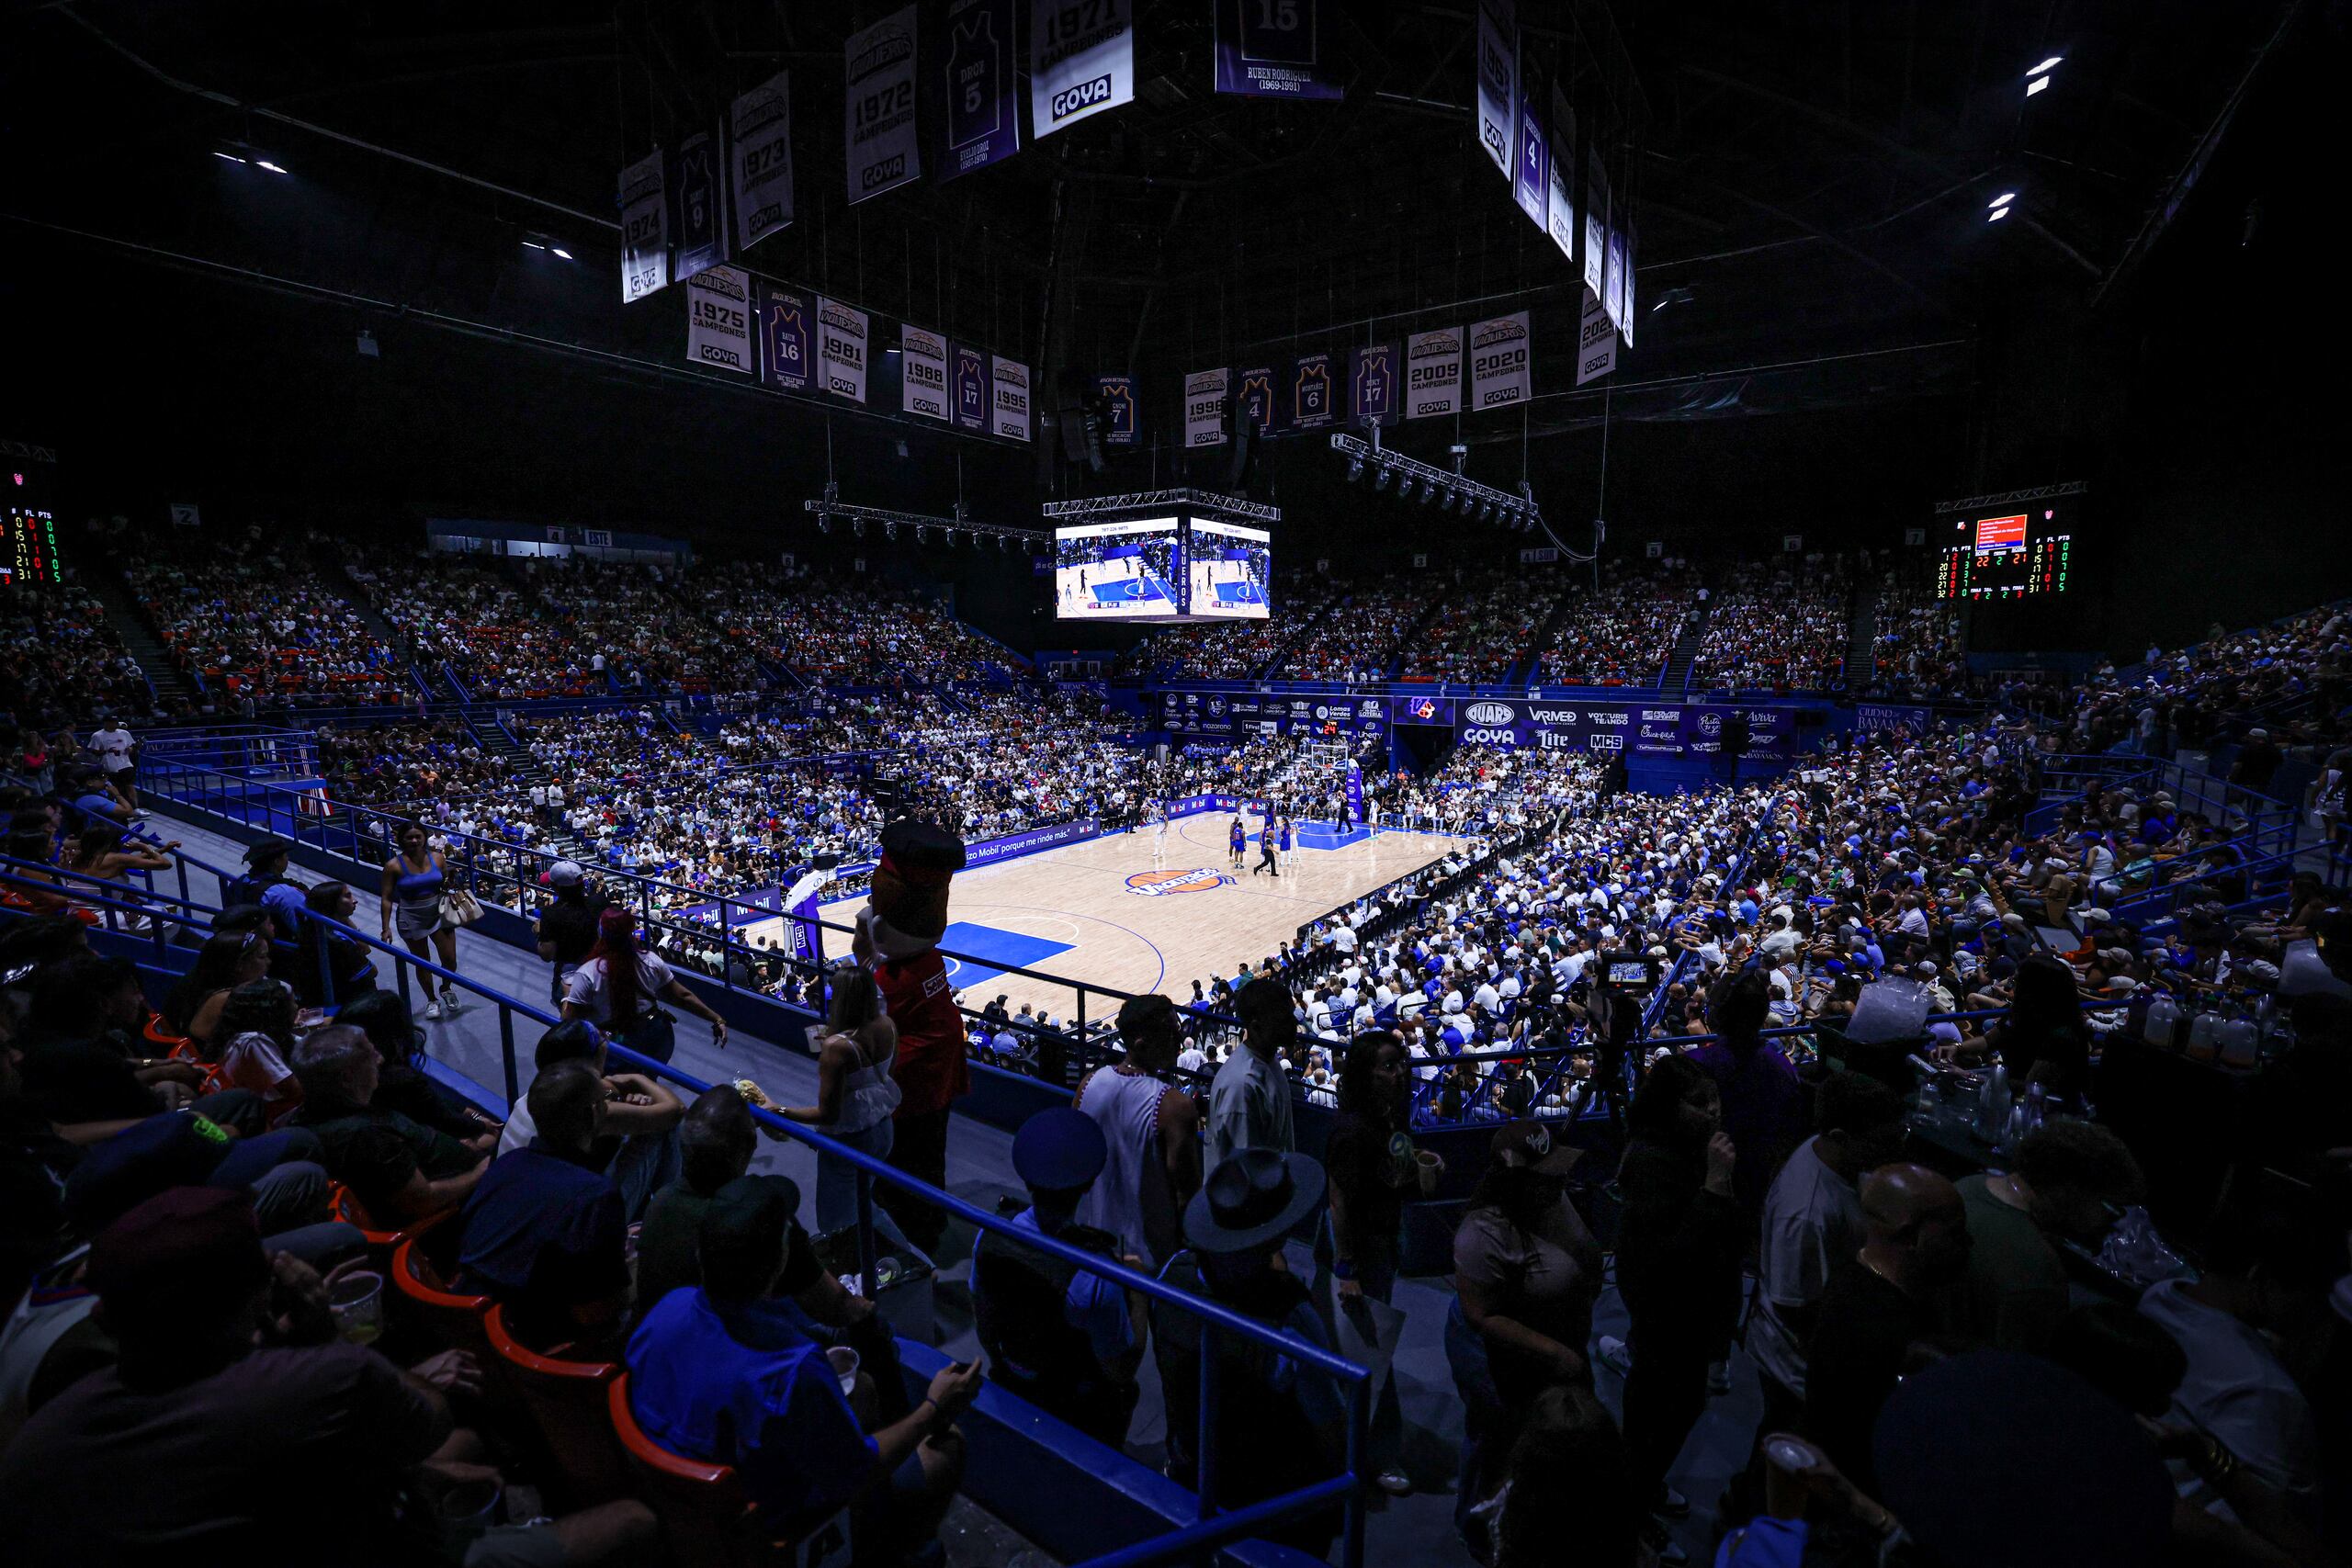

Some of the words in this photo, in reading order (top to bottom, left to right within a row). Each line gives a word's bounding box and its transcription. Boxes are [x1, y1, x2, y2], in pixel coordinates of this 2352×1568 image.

[1047, 0, 1116, 46] 1971
[1258, 0, 1298, 31] 15
[960, 61, 986, 81] DROZ
[1248, 67, 1272, 80] RUBEN
[1272, 68, 1312, 82] RODRIGUEZ
[854, 80, 912, 126] 1972
[965, 83, 982, 113] 5
[1054, 77, 1110, 118] GOYA
[742, 139, 785, 178] 1973
[1528, 141, 1537, 170] 4
[863, 155, 905, 186] GOYA
[692, 206, 705, 229] 9
[749, 204, 781, 235] GOYA
[694, 300, 744, 328] 1975
[692, 317, 747, 339] CAMPEONES
[702, 344, 740, 367] GOYA
[780, 342, 799, 361] 16
[823, 335, 863, 363] 1981
[1476, 349, 1526, 372] 2020
[1585, 354, 1609, 375] GOYA
[907, 361, 943, 383] 1988
[1411, 364, 1458, 382] 2009
[1476, 364, 1526, 381] CAMPEONES
[830, 377, 855, 396] OYA
[906, 376, 944, 391] CAMPEONES
[1411, 378, 1458, 390] CAMPEONES
[965, 389, 978, 405] 17
[997, 389, 1026, 408] 1995
[1307, 391, 1319, 407] 6
[1365, 387, 1381, 402] 17
[1485, 387, 1519, 405] GOYA
[913, 398, 940, 414] GOYA
[1250, 401, 1261, 417] 4
[1418, 400, 1450, 414] GOYA
[1113, 410, 1121, 423] 7
[1001, 423, 1023, 438] GOYA
[1194, 431, 1219, 444] GOYA
[39, 511, 51, 519] PTS
[16, 517, 22, 527] 0
[28, 518, 35, 529] 0
[47, 521, 53, 532] 0
[16, 530, 24, 540] 15
[49, 534, 55, 544] 0
[589, 532, 609, 545] ESTE
[17, 544, 27, 553] 17
[17, 556, 29, 566] 21
[34, 557, 41, 569] 0
[52, 558, 59, 570] 0
[1977, 557, 1989, 568] 22
[2013, 553, 2027, 564] 21
[2034, 554, 2041, 563] 15
[1939, 563, 1948, 571] 20
[2033, 564, 2041, 572] 17
[18, 570, 31, 580] 31
[54, 571, 61, 582] 5
[1939, 572, 1947, 581] 22
[2030, 575, 2040, 583] 21
[1938, 581, 1947, 590] 27
[2029, 584, 2040, 593] 31
[1747, 711, 1777, 722] Aviva
[1859, 707, 1893, 718] CIUDAD
[1324, 725, 1335, 734] 24
[1464, 728, 1515, 744] GOYA
[1538, 731, 1569, 750] Lite
[1592, 736, 1622, 748] MCS
[1170, 804, 1185, 814] Mobil
[1216, 799, 1236, 808] Mobil
[1248, 801, 1266, 811] Mobil
[1080, 824, 1093, 834] Mobil
[1001, 841, 1025, 854] porque
[1026, 839, 1036, 847] me
[1037, 831, 1054, 844] rinde
[797, 927, 806, 948] MCS
